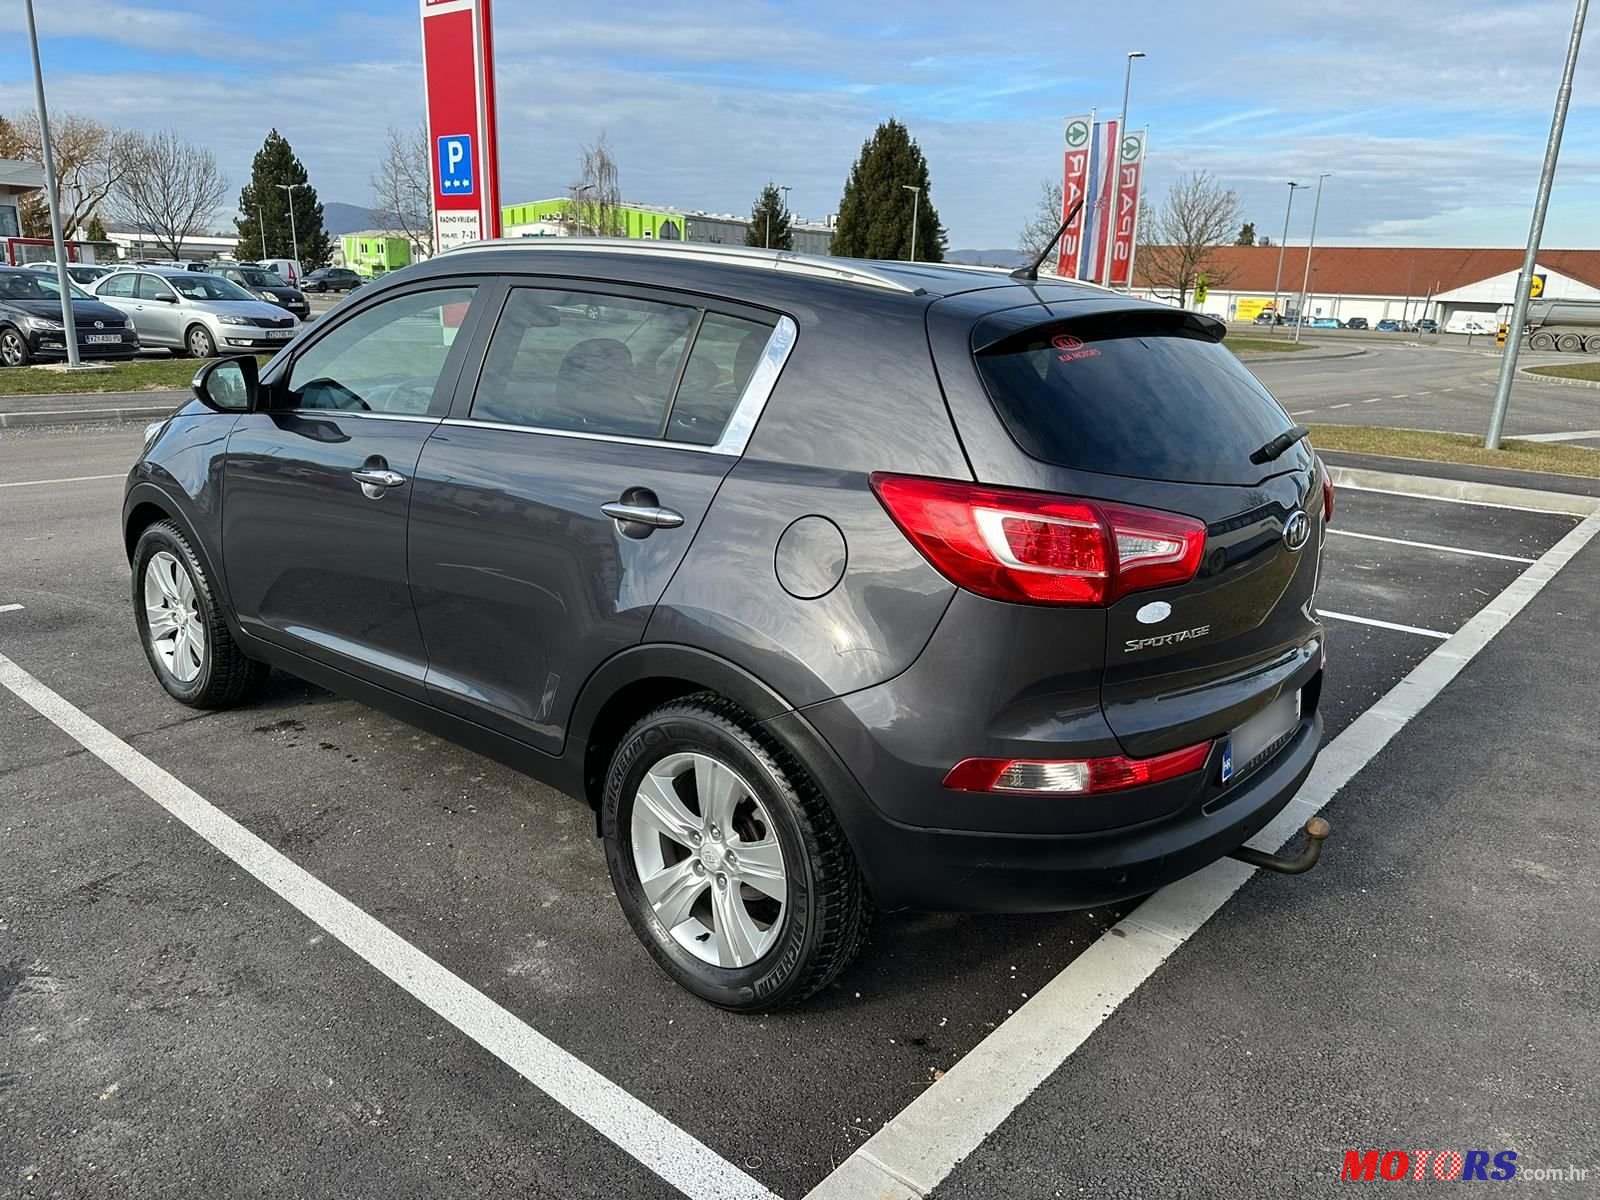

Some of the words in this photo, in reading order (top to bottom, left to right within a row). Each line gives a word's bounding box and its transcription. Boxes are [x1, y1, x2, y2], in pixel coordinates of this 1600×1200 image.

[447, 140, 464, 174] P
[439, 215, 457, 223] RADNO
[1055, 338, 1081, 348] KIA
[1124, 625, 1210, 653] SPORTAGE
[606, 736, 644, 816] MICHELIN
[753, 920, 806, 1000] MICHELIN
